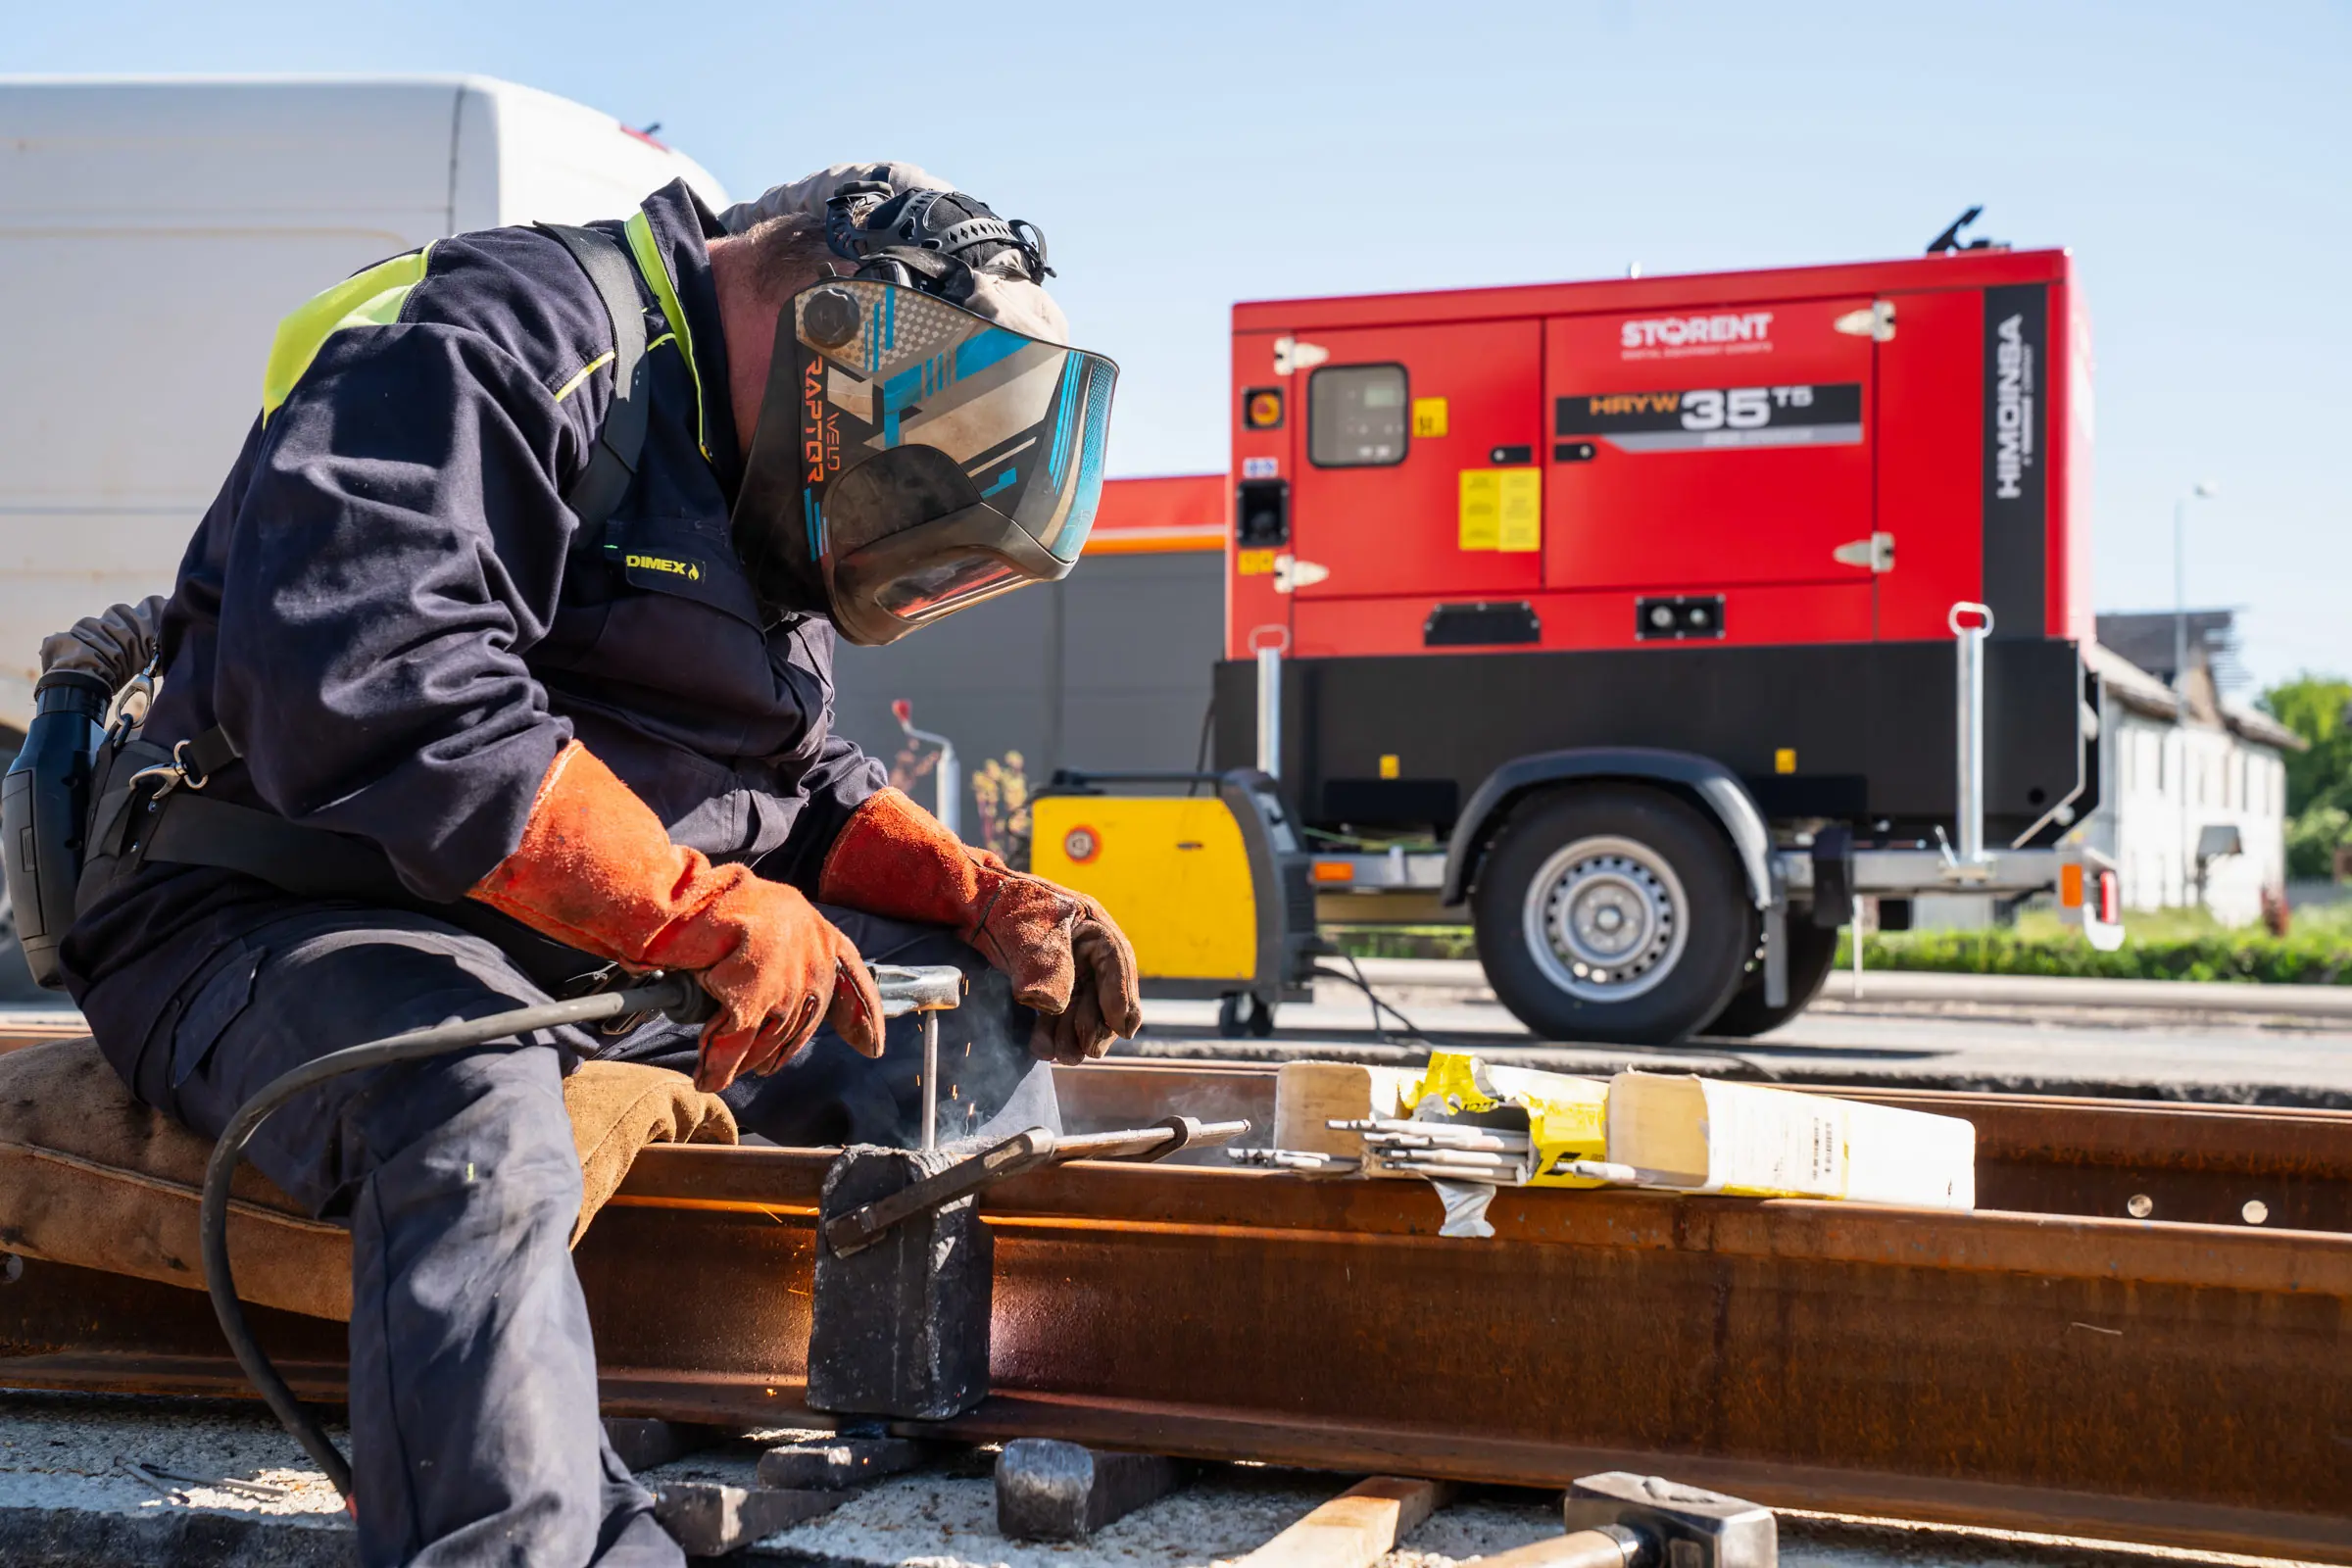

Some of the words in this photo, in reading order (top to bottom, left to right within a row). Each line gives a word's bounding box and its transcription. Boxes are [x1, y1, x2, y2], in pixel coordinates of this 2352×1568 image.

[1621, 313, 1774, 347] STORENT
[805, 355, 824, 483] RAPTOR
[1681, 388, 1771, 430] 35
[1996, 313, 2023, 499] HIMOINSA
[826, 412, 841, 471] WELD
[625, 555, 687, 575] DIMEX
